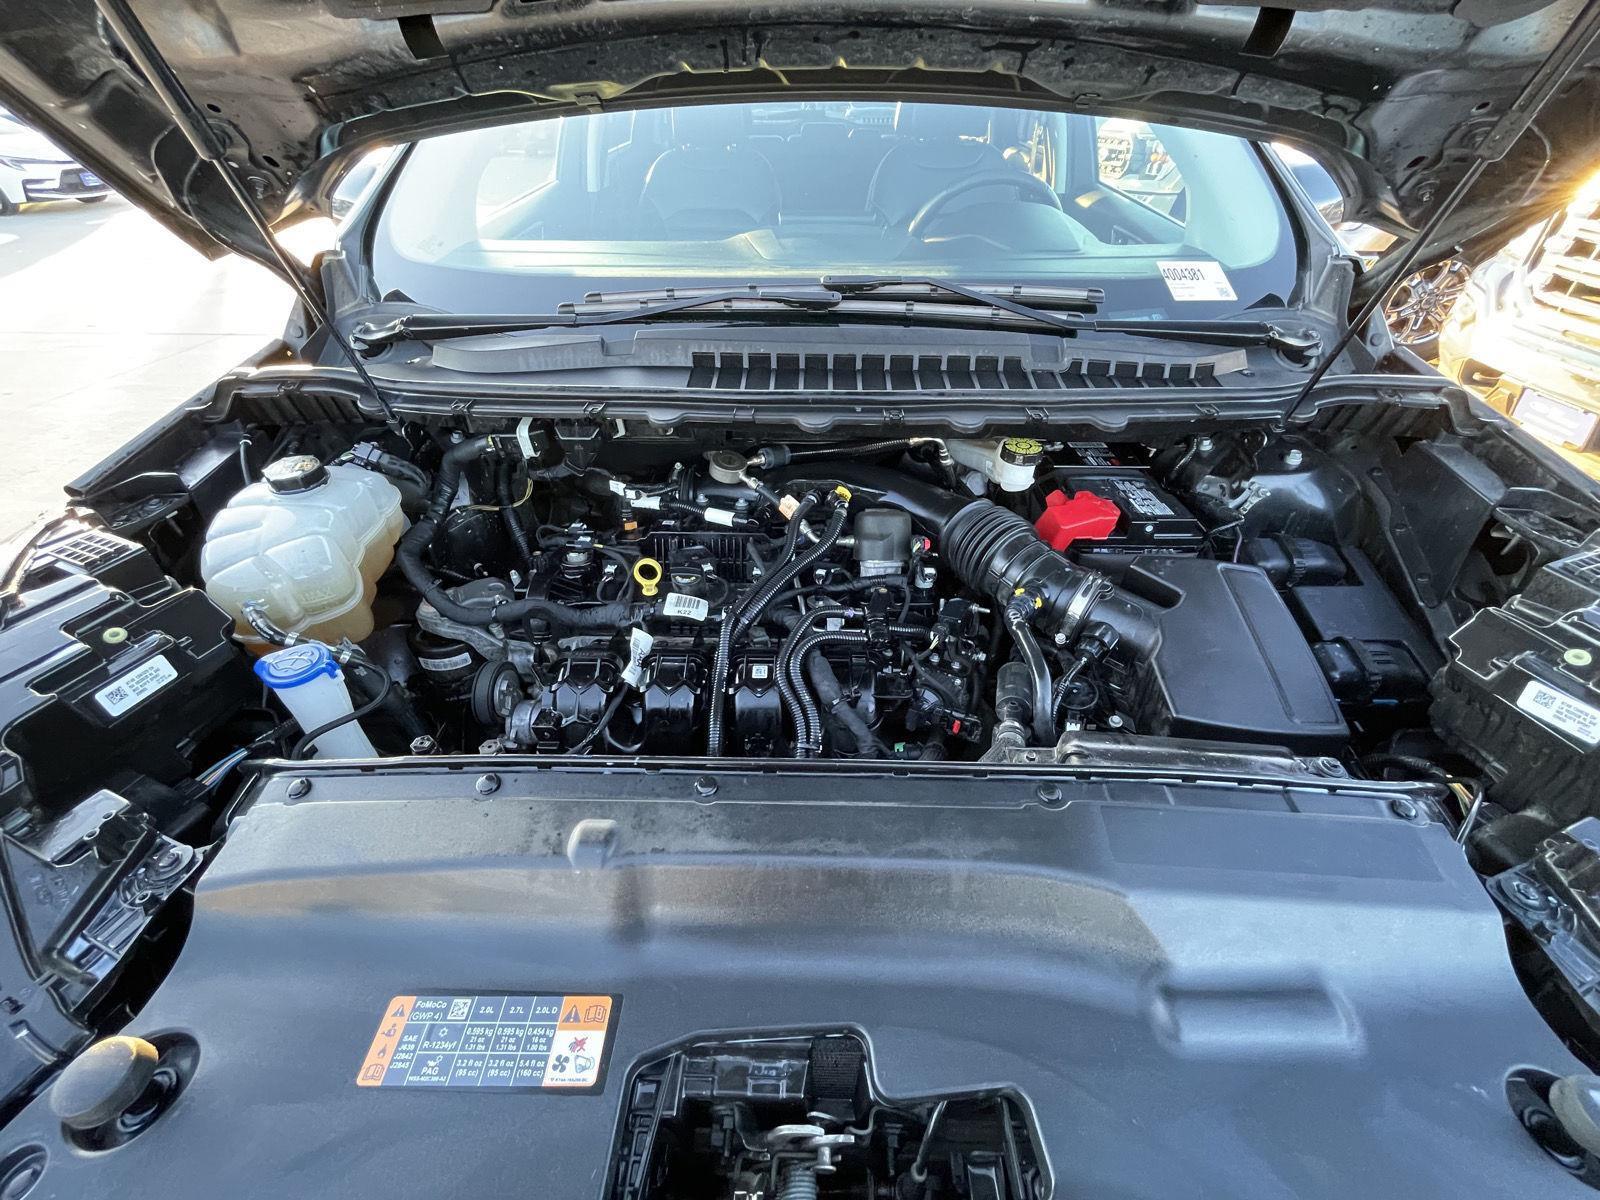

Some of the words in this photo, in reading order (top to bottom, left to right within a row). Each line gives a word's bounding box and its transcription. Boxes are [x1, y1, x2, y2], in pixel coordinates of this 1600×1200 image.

[1162, 267, 1206, 281] 4004381
[415, 1000, 447, 1009] FoMoCo
[479, 1006, 494, 1014] 2.0L
[509, 1006, 524, 1014] 2.7L
[535, 1006, 551, 1014] 2.0L
[551, 1006, 558, 1014] D
[409, 1012, 433, 1021] (GWP
[433, 1012, 443, 1021] 4)
[485, 1027, 494, 1037] kg
[515, 1027, 525, 1037] kg
[545, 1027, 555, 1037] kg
[422, 1040, 457, 1049] R-1234yf
[456, 1059, 468, 1067] 3.2
[488, 1059, 499, 1067] 3.2
[519, 1059, 530, 1067] 5.4
[420, 1066, 439, 1075] PAG
[455, 1068, 468, 1078] (95
[468, 1068, 479, 1078] cc)
[487, 1068, 500, 1078] (95
[500, 1068, 511, 1078] cc)
[516, 1068, 532, 1078] (160
[532, 1068, 544, 1078] cc)
